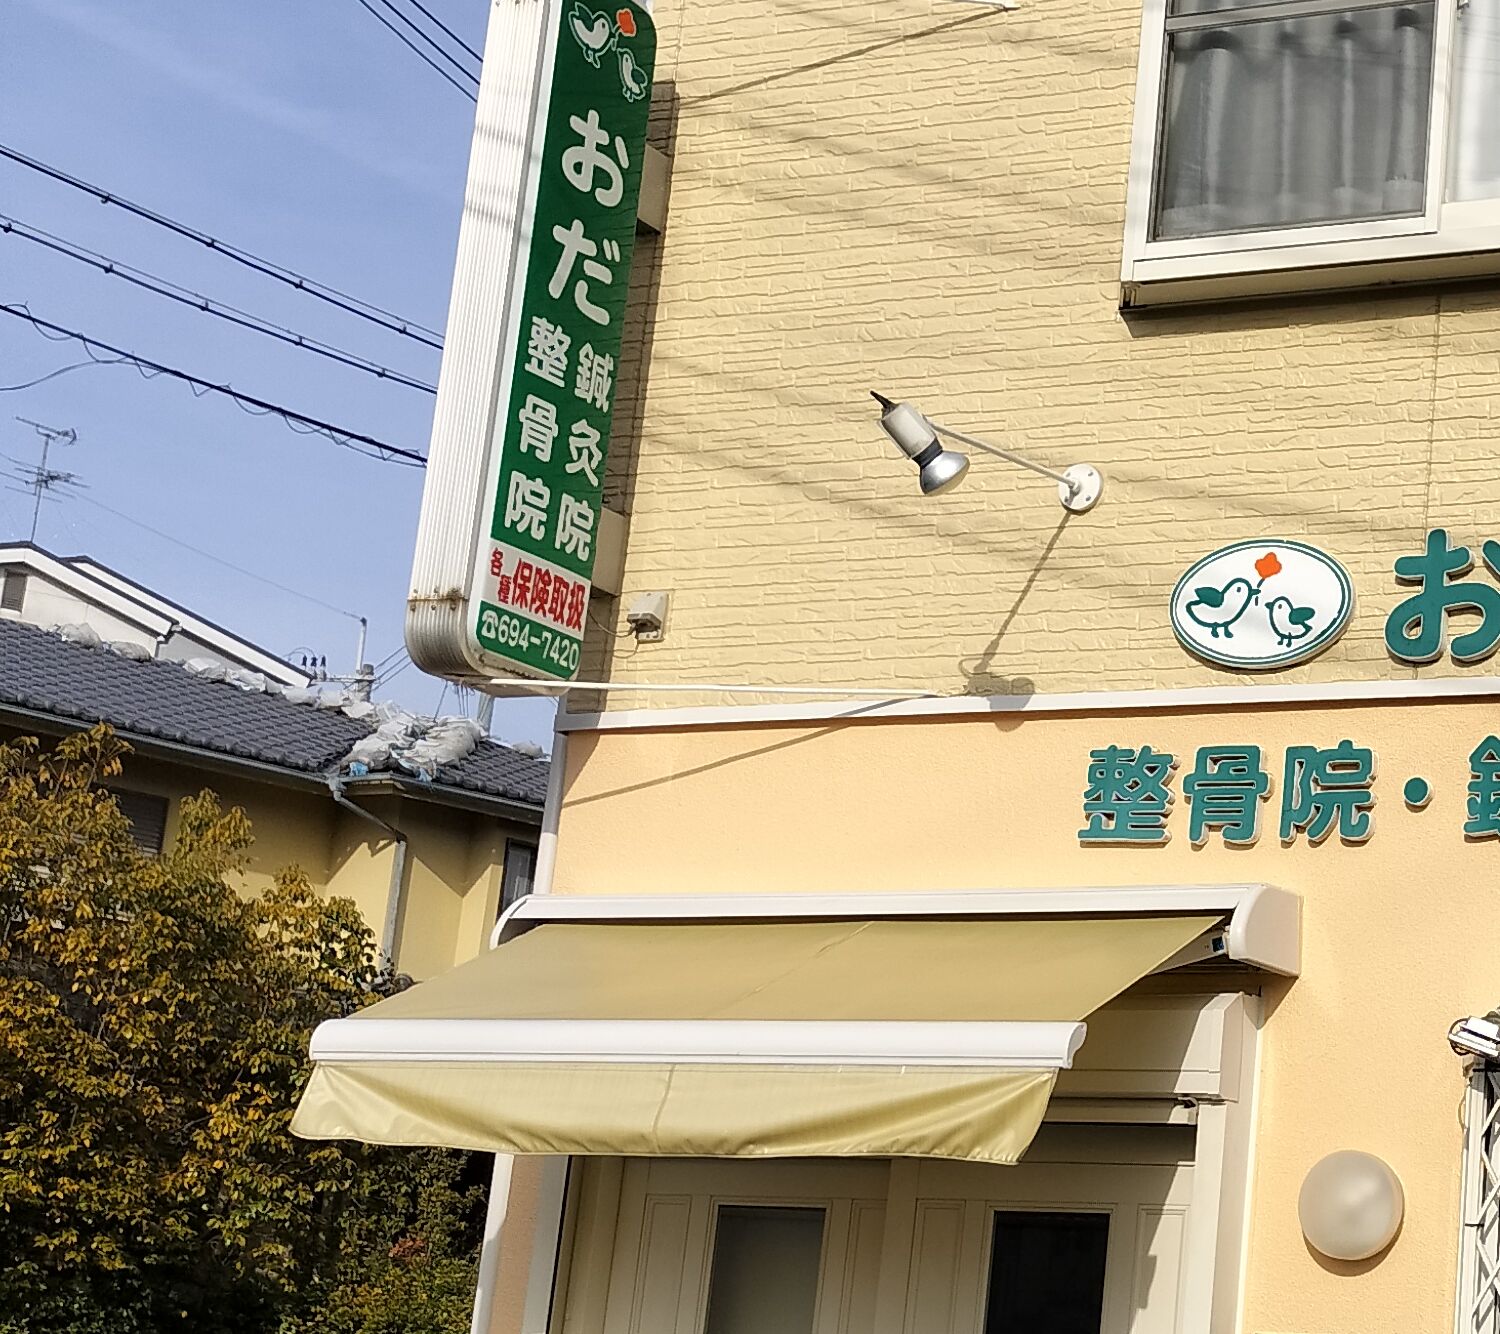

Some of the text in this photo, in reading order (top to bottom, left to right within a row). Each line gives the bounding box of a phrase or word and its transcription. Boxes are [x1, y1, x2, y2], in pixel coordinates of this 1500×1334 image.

[547, 108, 630, 327] おだ
[503, 315, 572, 542] 整骨院
[554, 341, 617, 562] 鍼灸院
[498, 614, 580, 671] 694-7420
